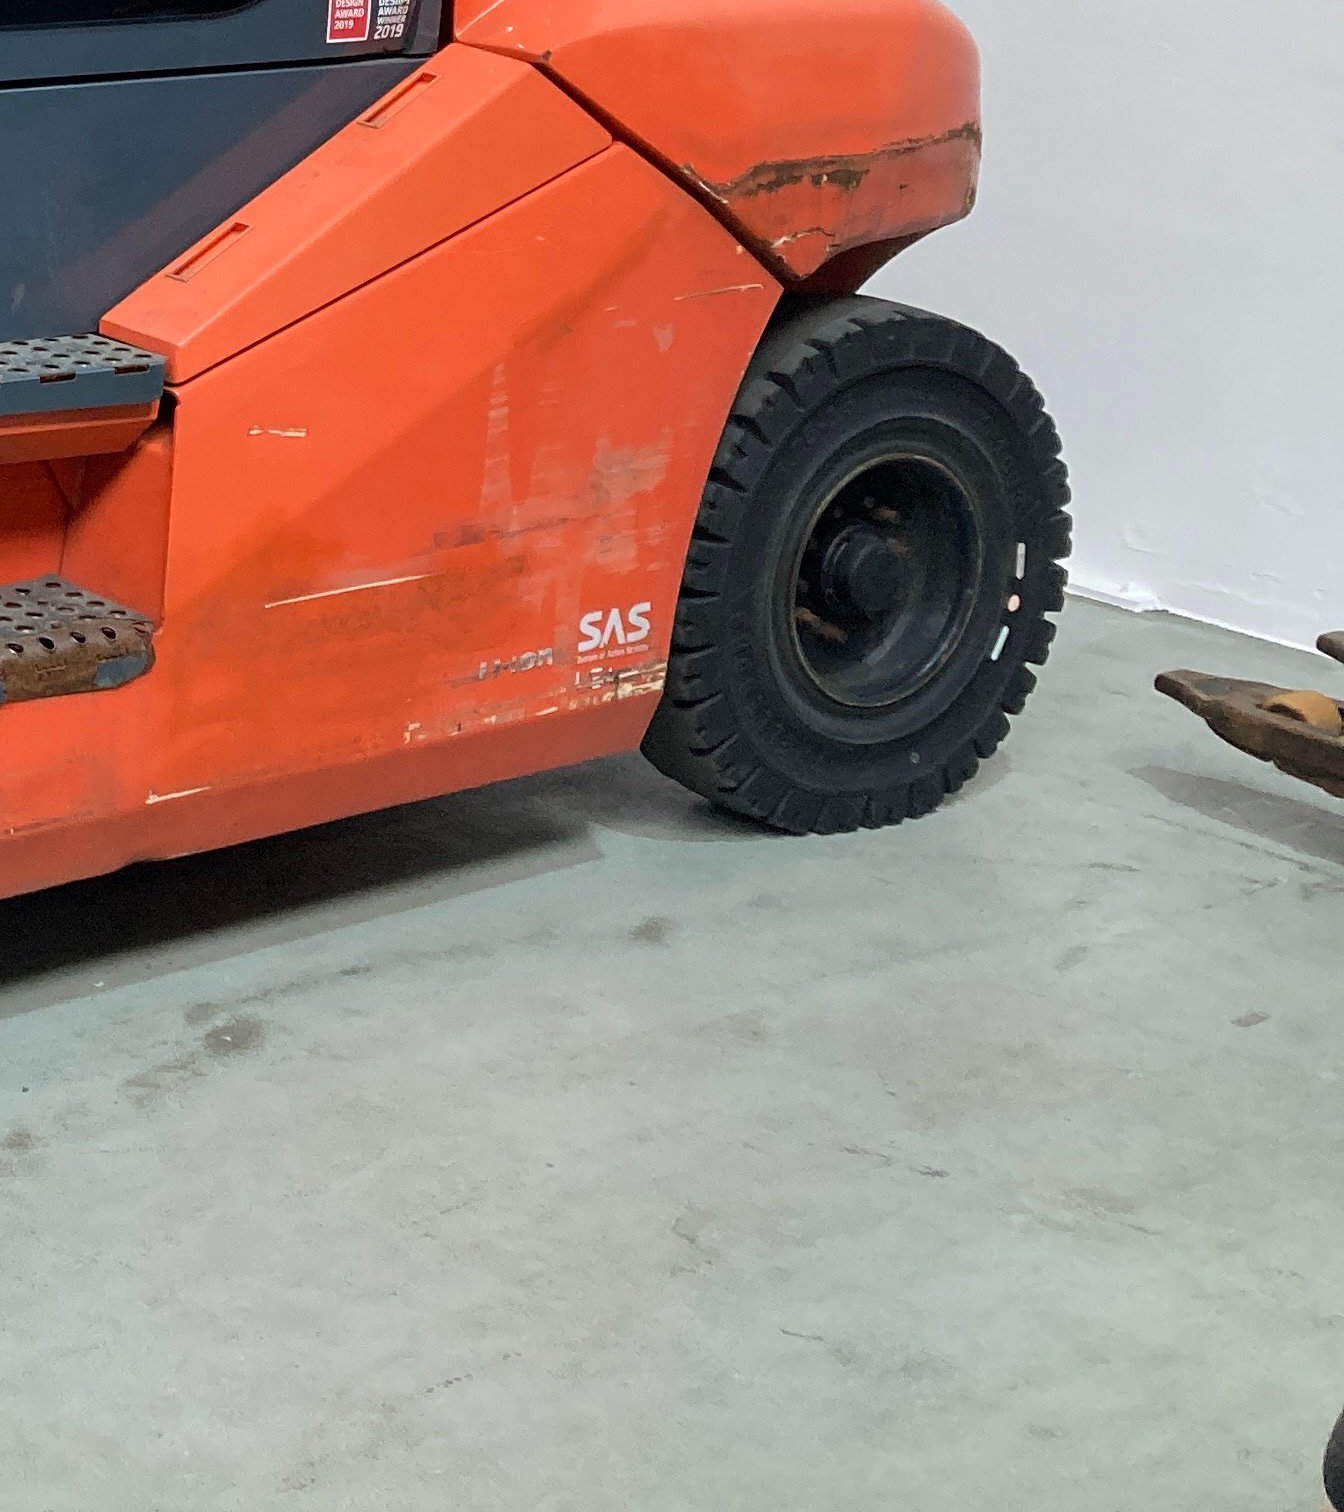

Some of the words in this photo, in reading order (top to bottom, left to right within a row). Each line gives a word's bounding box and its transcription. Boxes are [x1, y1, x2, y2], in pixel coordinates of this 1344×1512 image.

[334, 7, 365, 19] AWARD
[377, 5, 409, 17] AWARD
[333, 19, 355, 30] 2019
[373, 23, 405, 40] 2019
[577, 601, 652, 653] SAS
